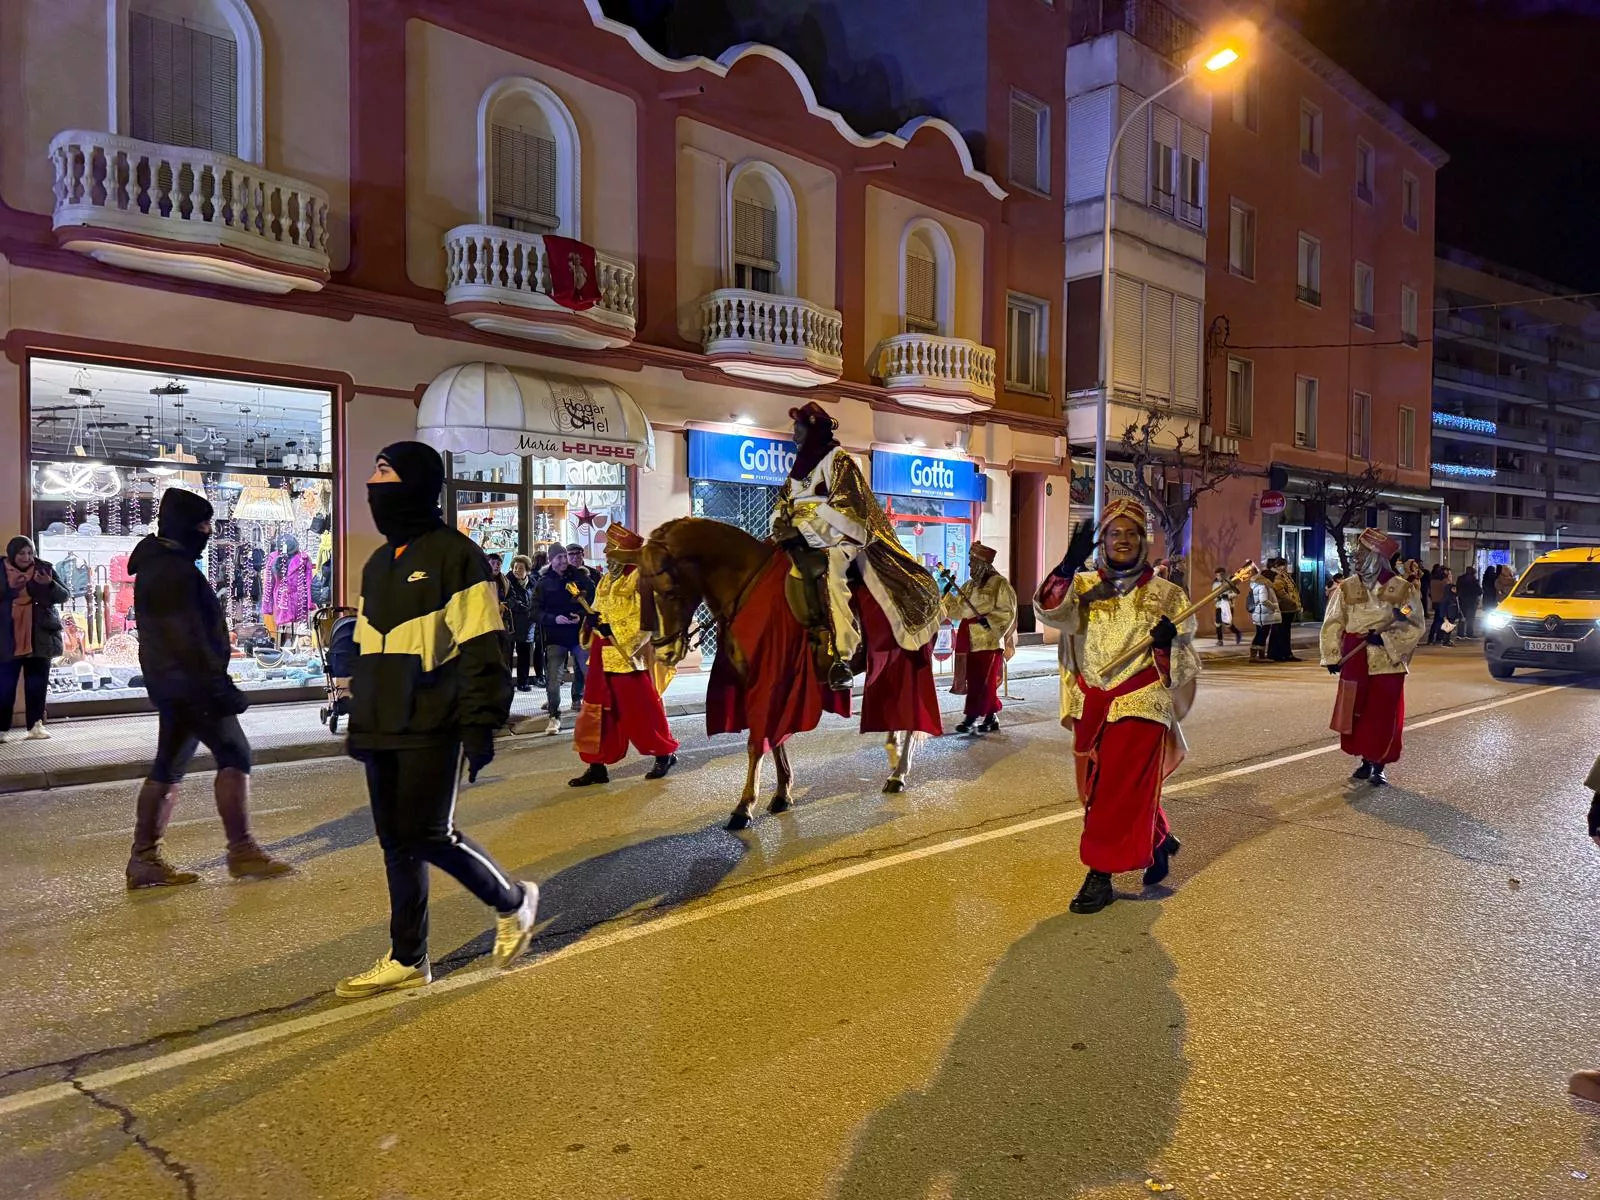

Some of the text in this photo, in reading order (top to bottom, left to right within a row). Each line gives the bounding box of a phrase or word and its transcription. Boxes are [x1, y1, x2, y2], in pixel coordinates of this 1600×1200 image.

[562, 398, 605, 416] Hogar
[582, 415, 609, 433] Piel
[515, 434, 559, 452] María
[911, 459, 954, 489] Gotta
